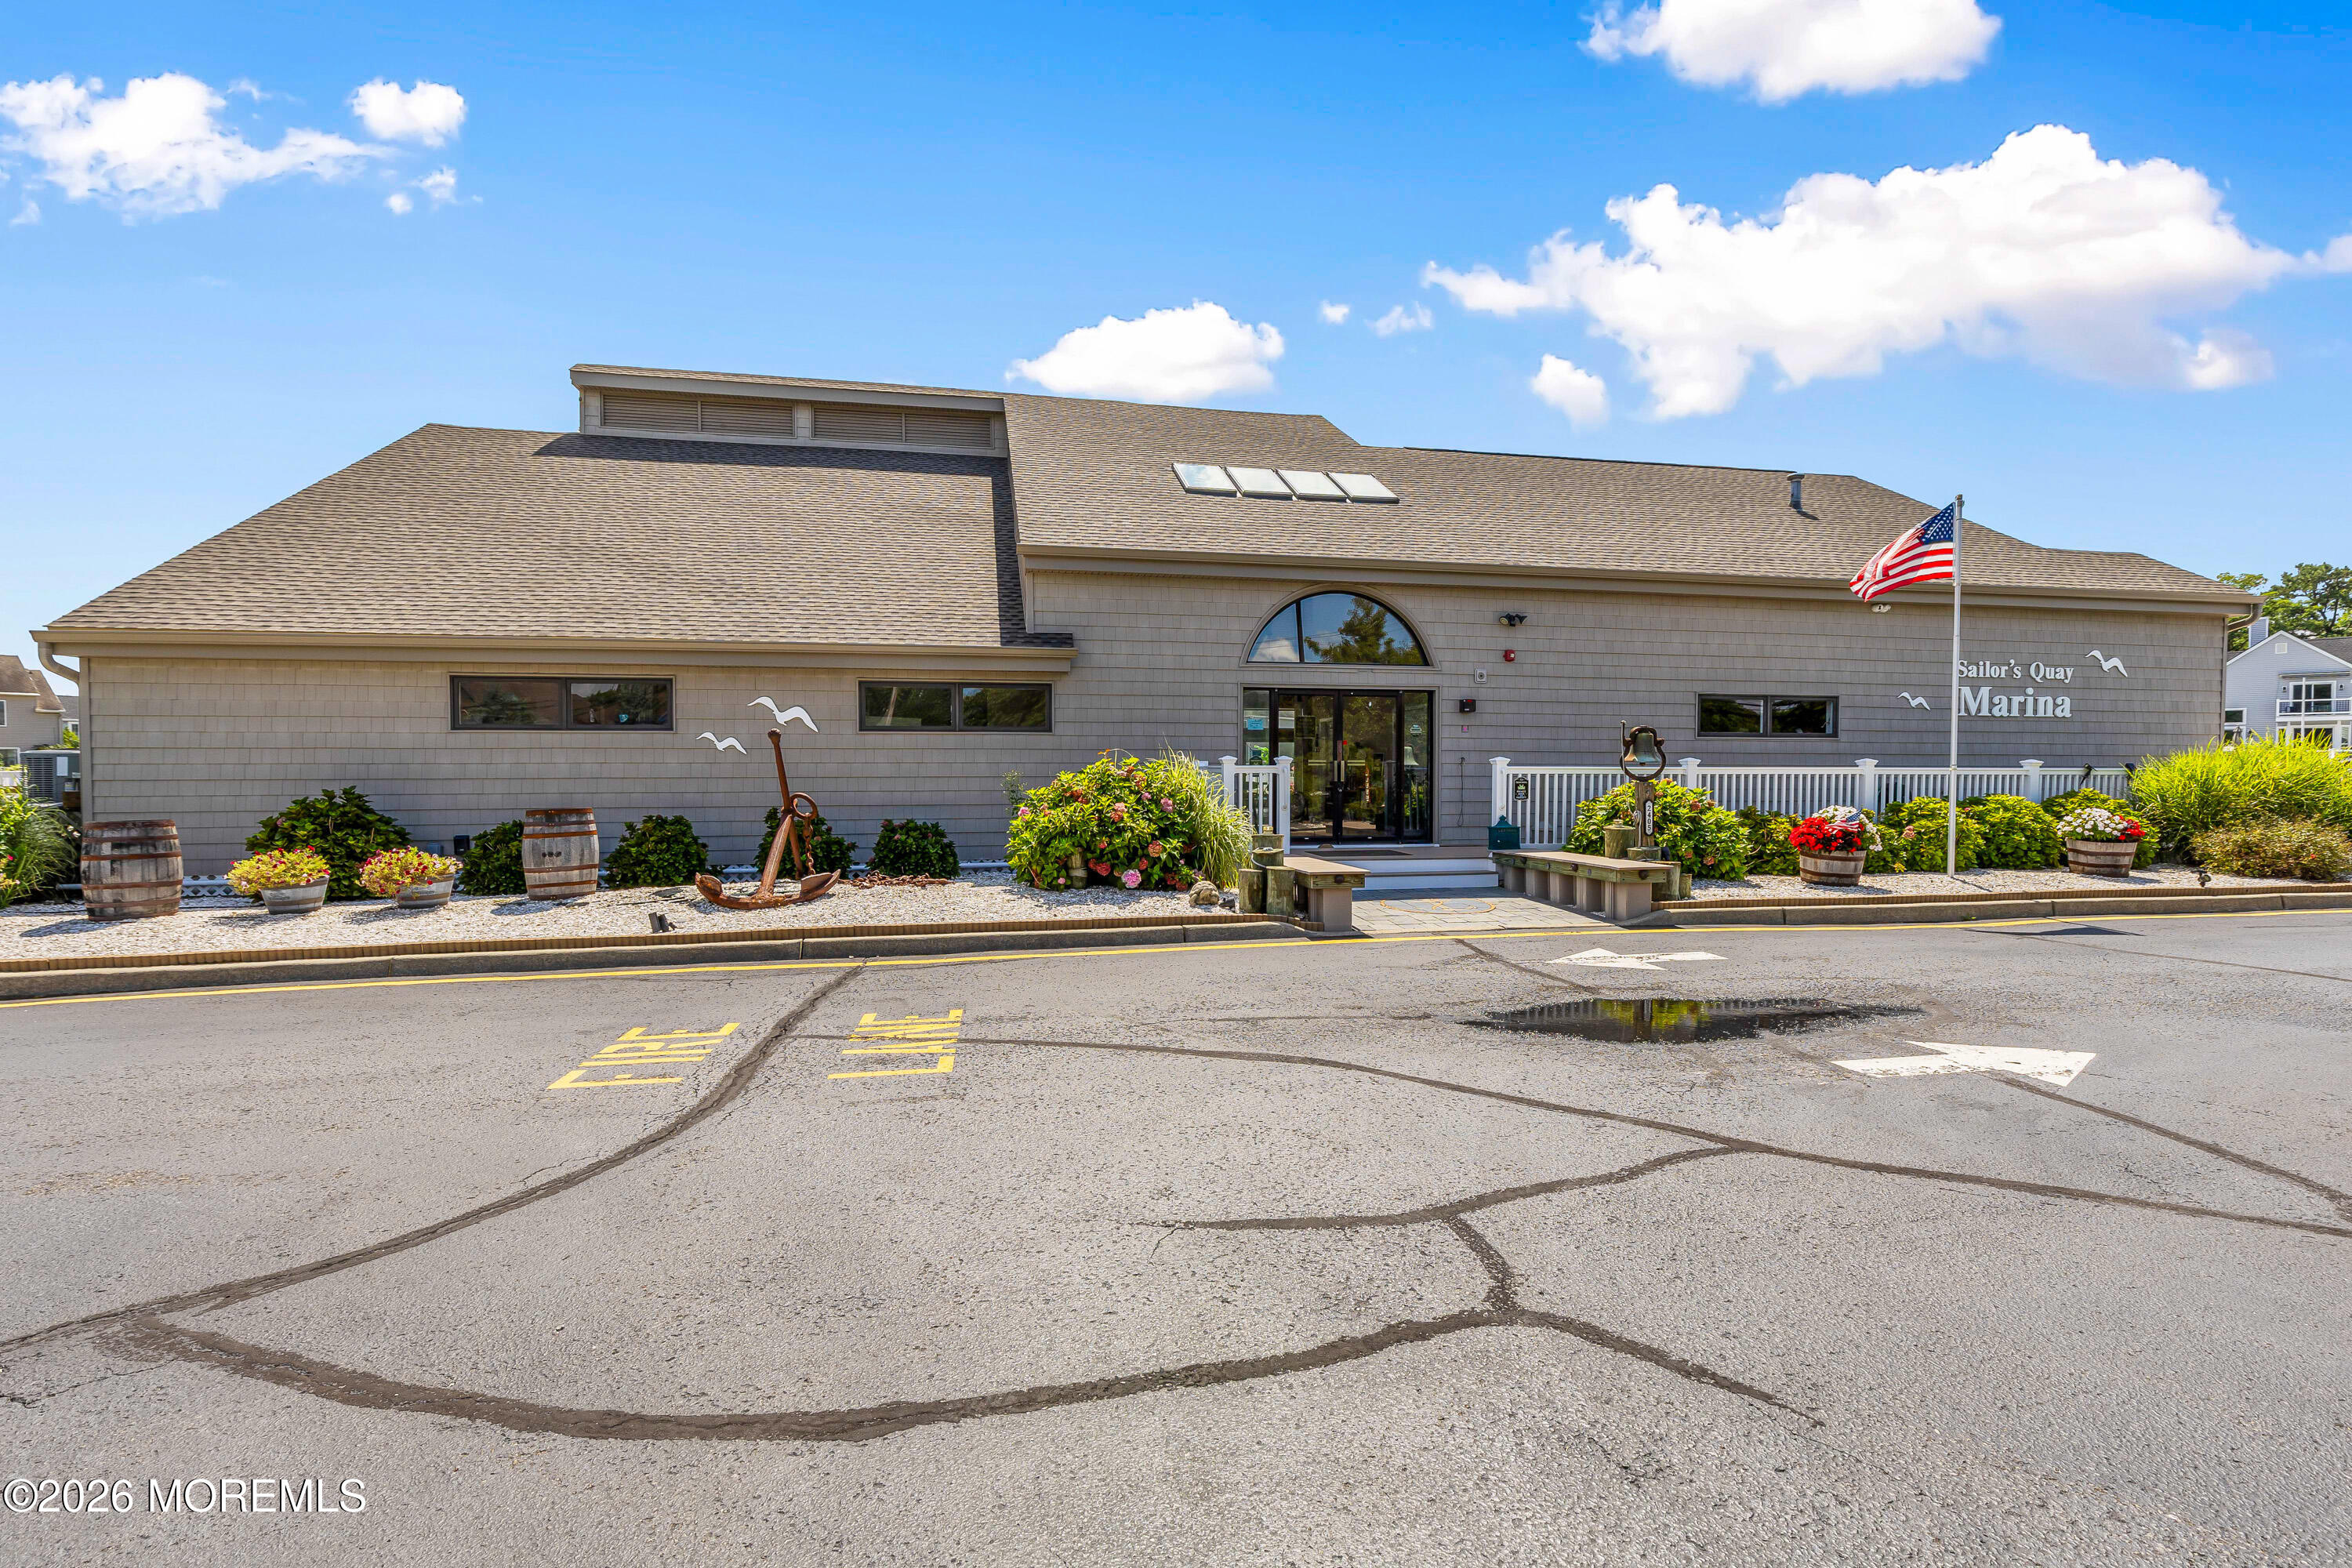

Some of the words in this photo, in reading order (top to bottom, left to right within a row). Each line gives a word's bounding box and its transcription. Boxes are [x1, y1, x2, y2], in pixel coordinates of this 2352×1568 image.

[1958, 659, 2022, 679] Sailor's
[2029, 662, 2074, 684] Quay
[1958, 686, 2072, 718] Marina
[546, 1022, 741, 1090] FIRE
[827, 1009, 964, 1080] LANE
